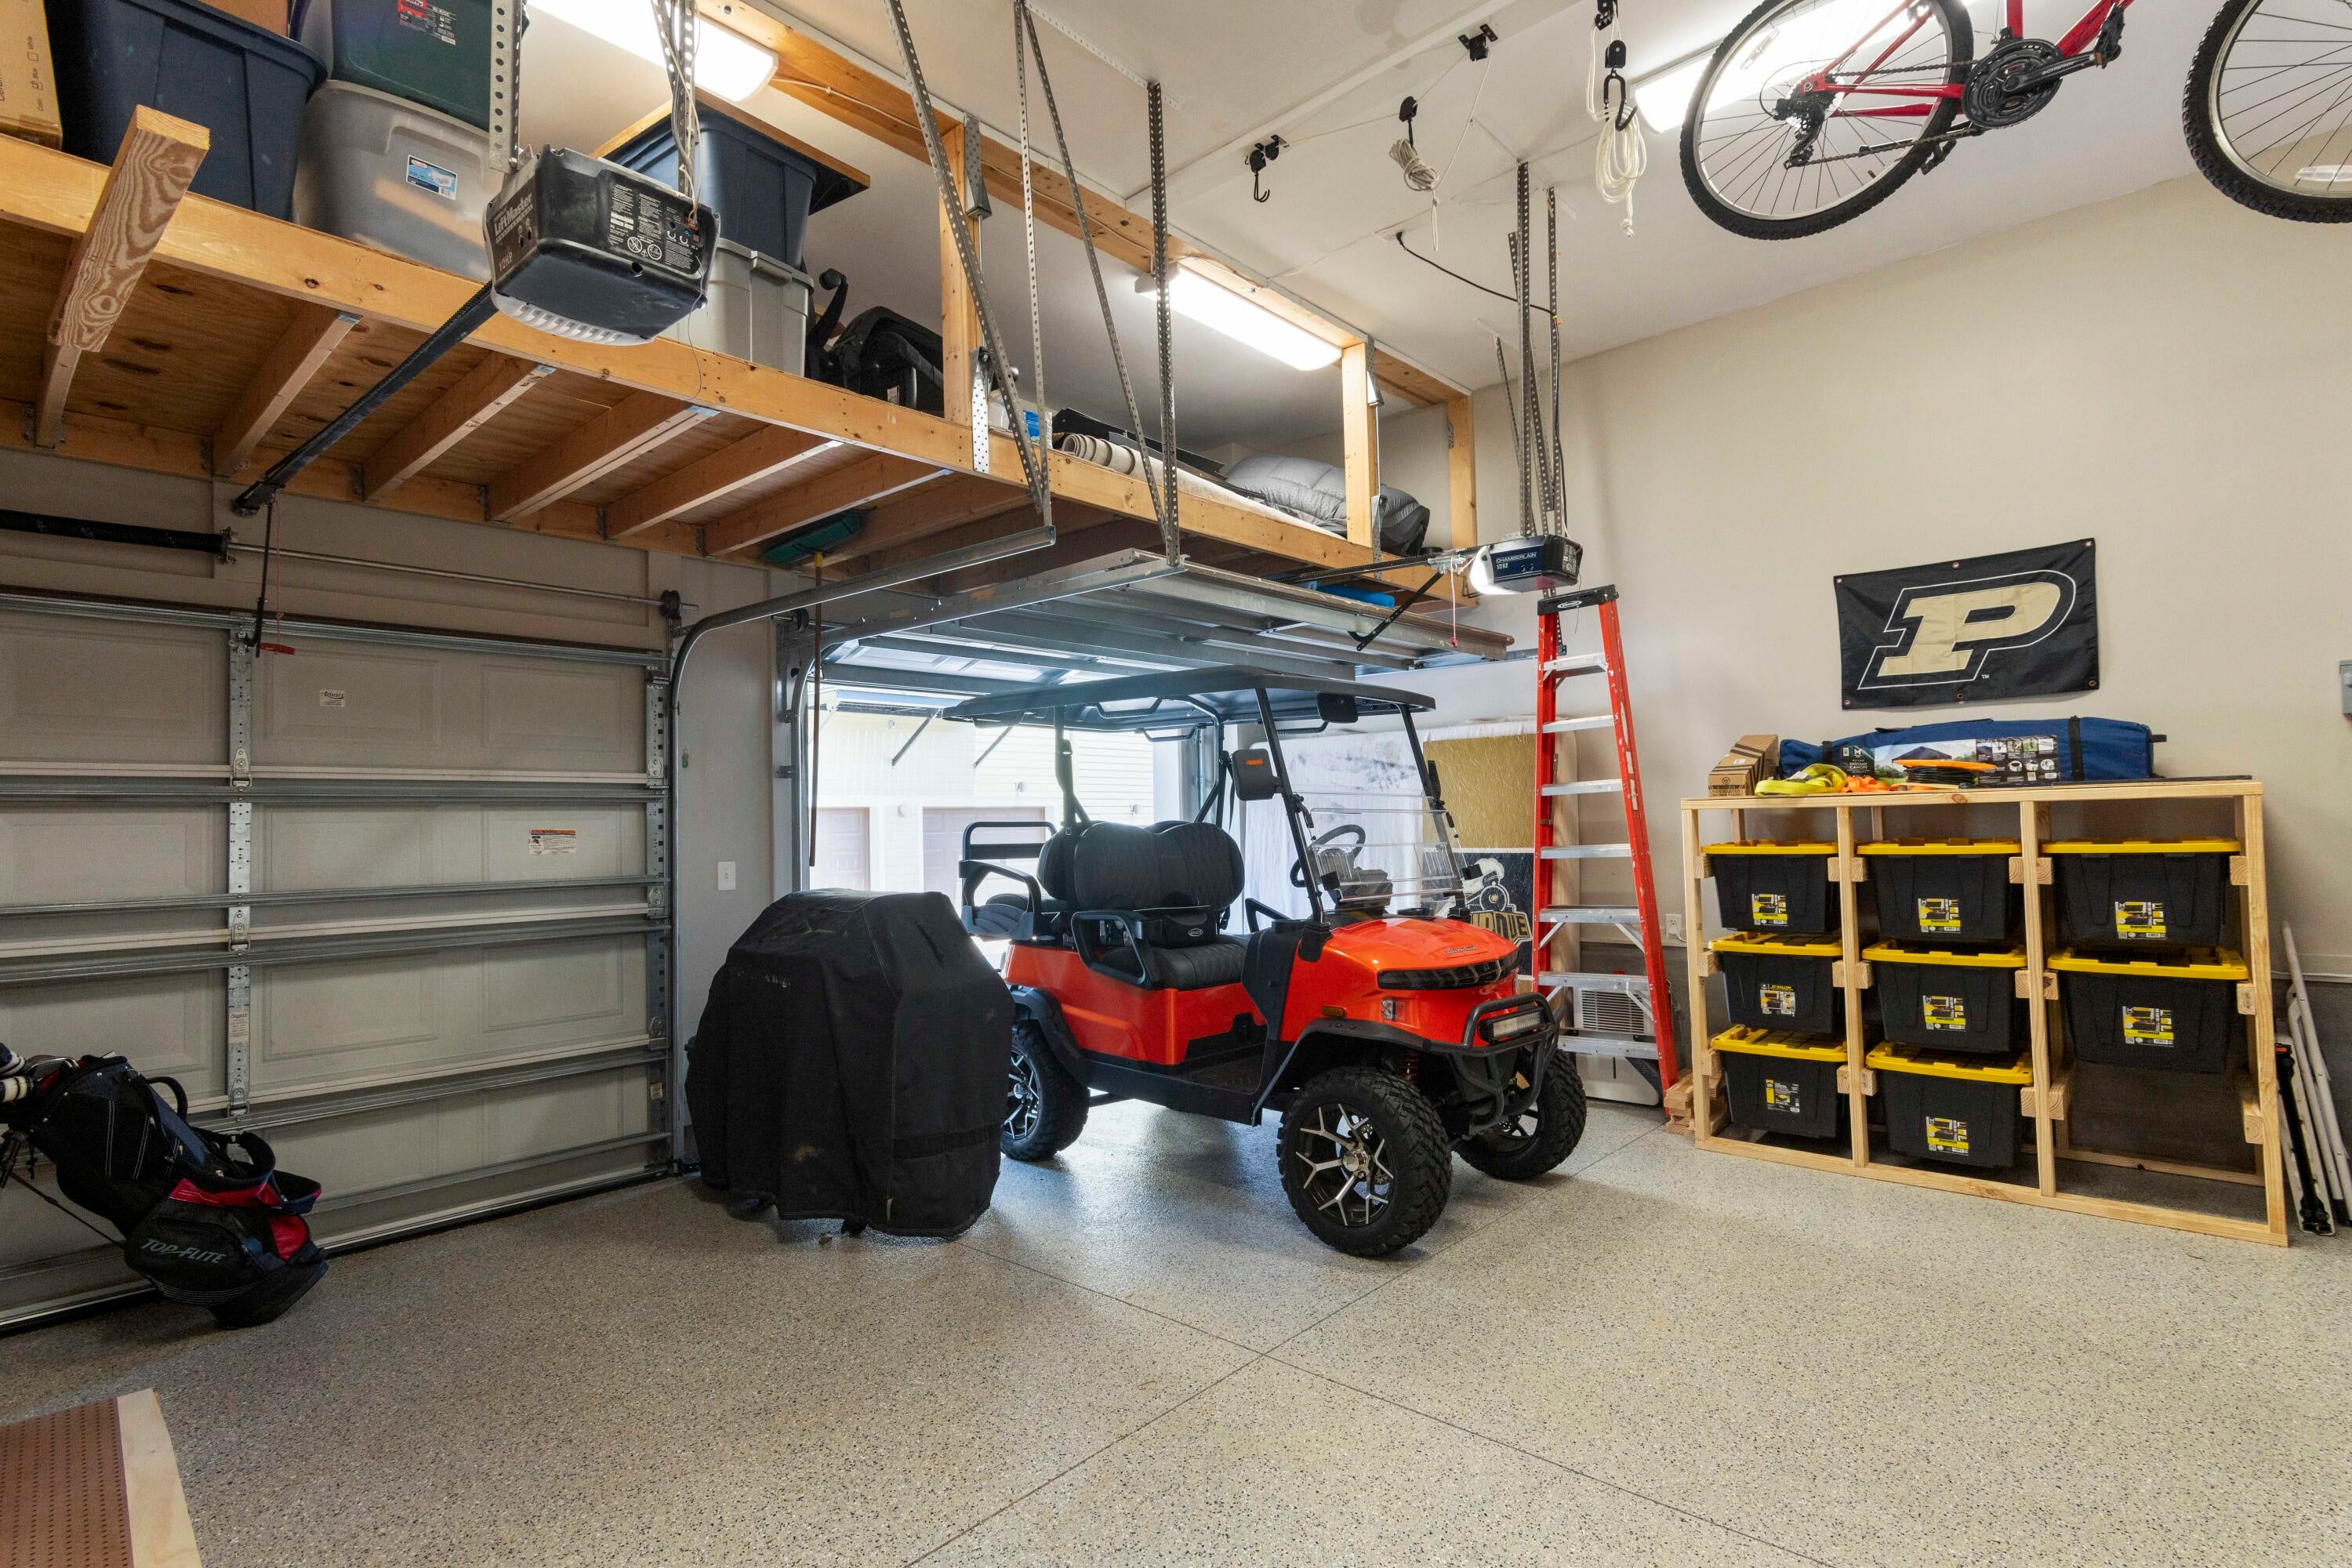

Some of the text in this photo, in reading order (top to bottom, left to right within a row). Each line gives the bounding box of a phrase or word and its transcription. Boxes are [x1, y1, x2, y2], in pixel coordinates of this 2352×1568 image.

[2042, 61, 2075, 75] SCHWINN
[494, 192, 532, 238] LiftMaster
[1496, 551, 1537, 564] CHAMBERLAIN
[1877, 582, 2061, 677] P
